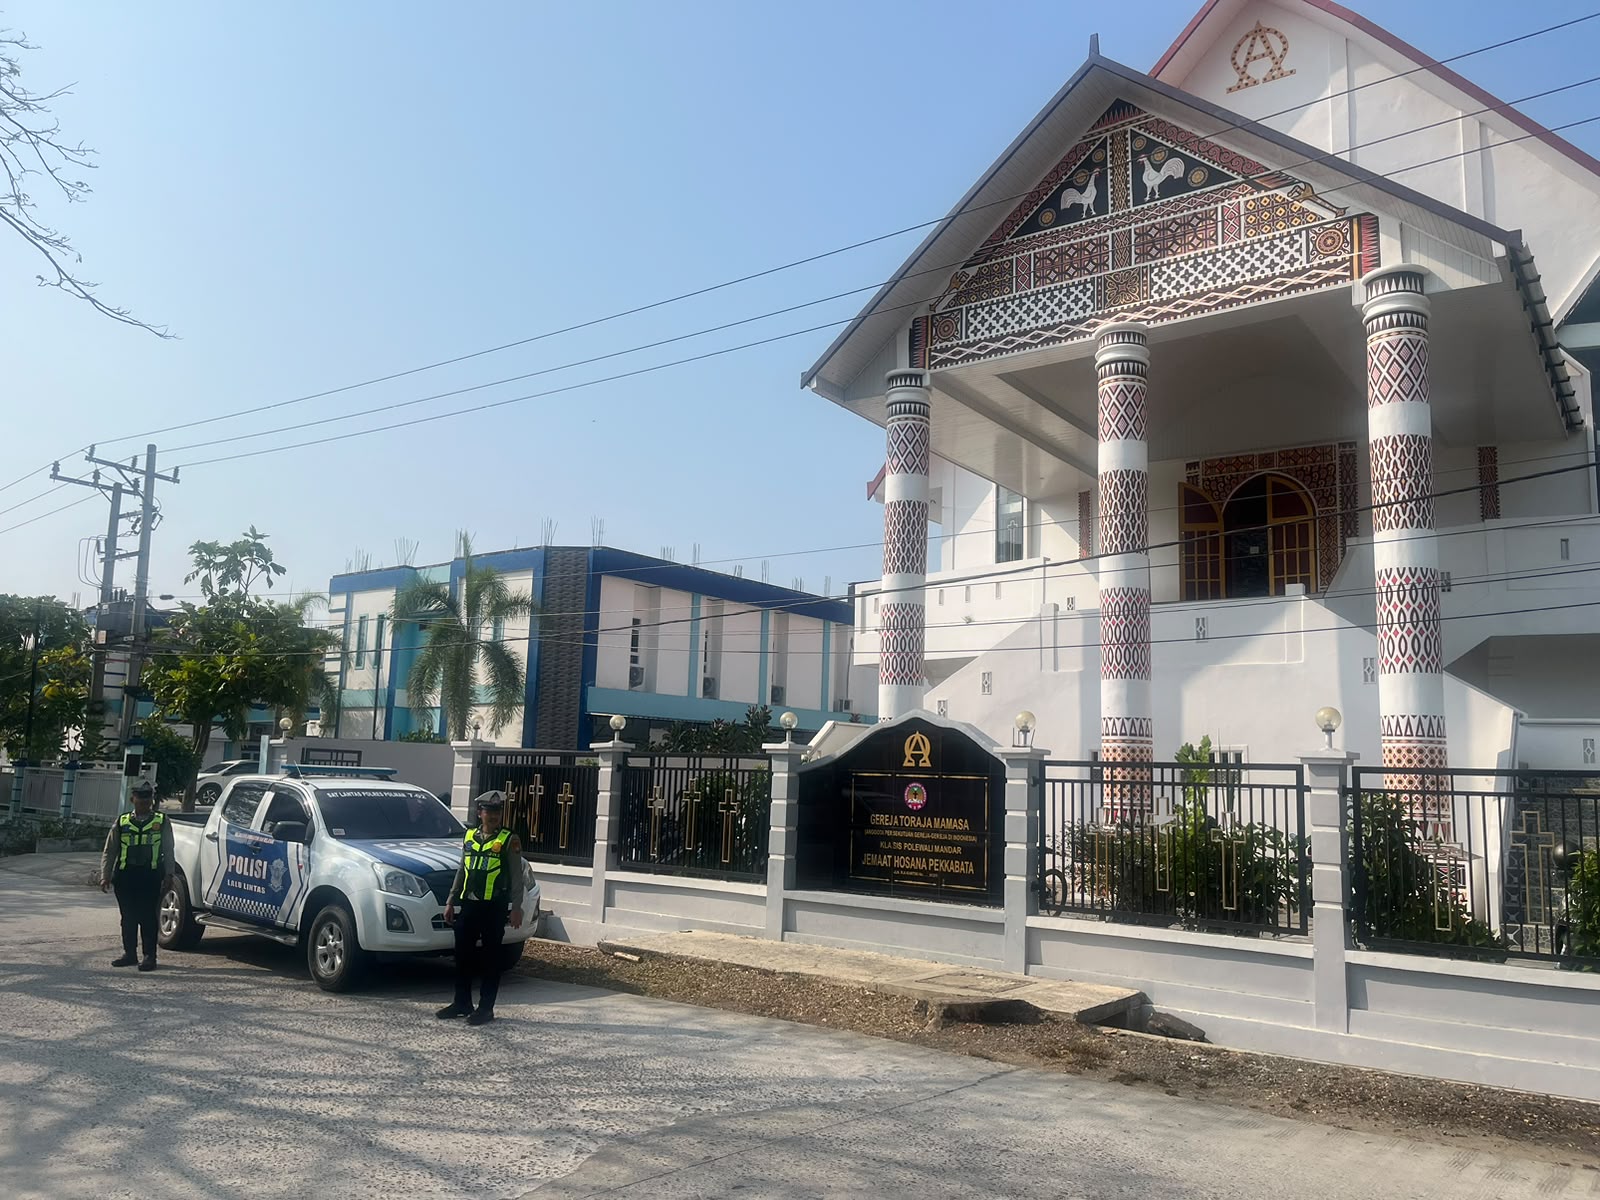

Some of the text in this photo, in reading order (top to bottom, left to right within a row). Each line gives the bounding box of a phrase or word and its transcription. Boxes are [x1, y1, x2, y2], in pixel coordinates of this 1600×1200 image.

[870, 813, 970, 831] GEREJA TORAJA MAMASA
[903, 842, 934, 853] POLEWALI
[934, 845, 962, 855] MANDAR
[228, 854, 268, 879] POLISI
[862, 853, 892, 868] JEMAAT
[893, 855, 927, 871] HOSANA
[928, 858, 975, 875] PEKKABATA
[228, 880, 266, 894] LALU LINTAS
